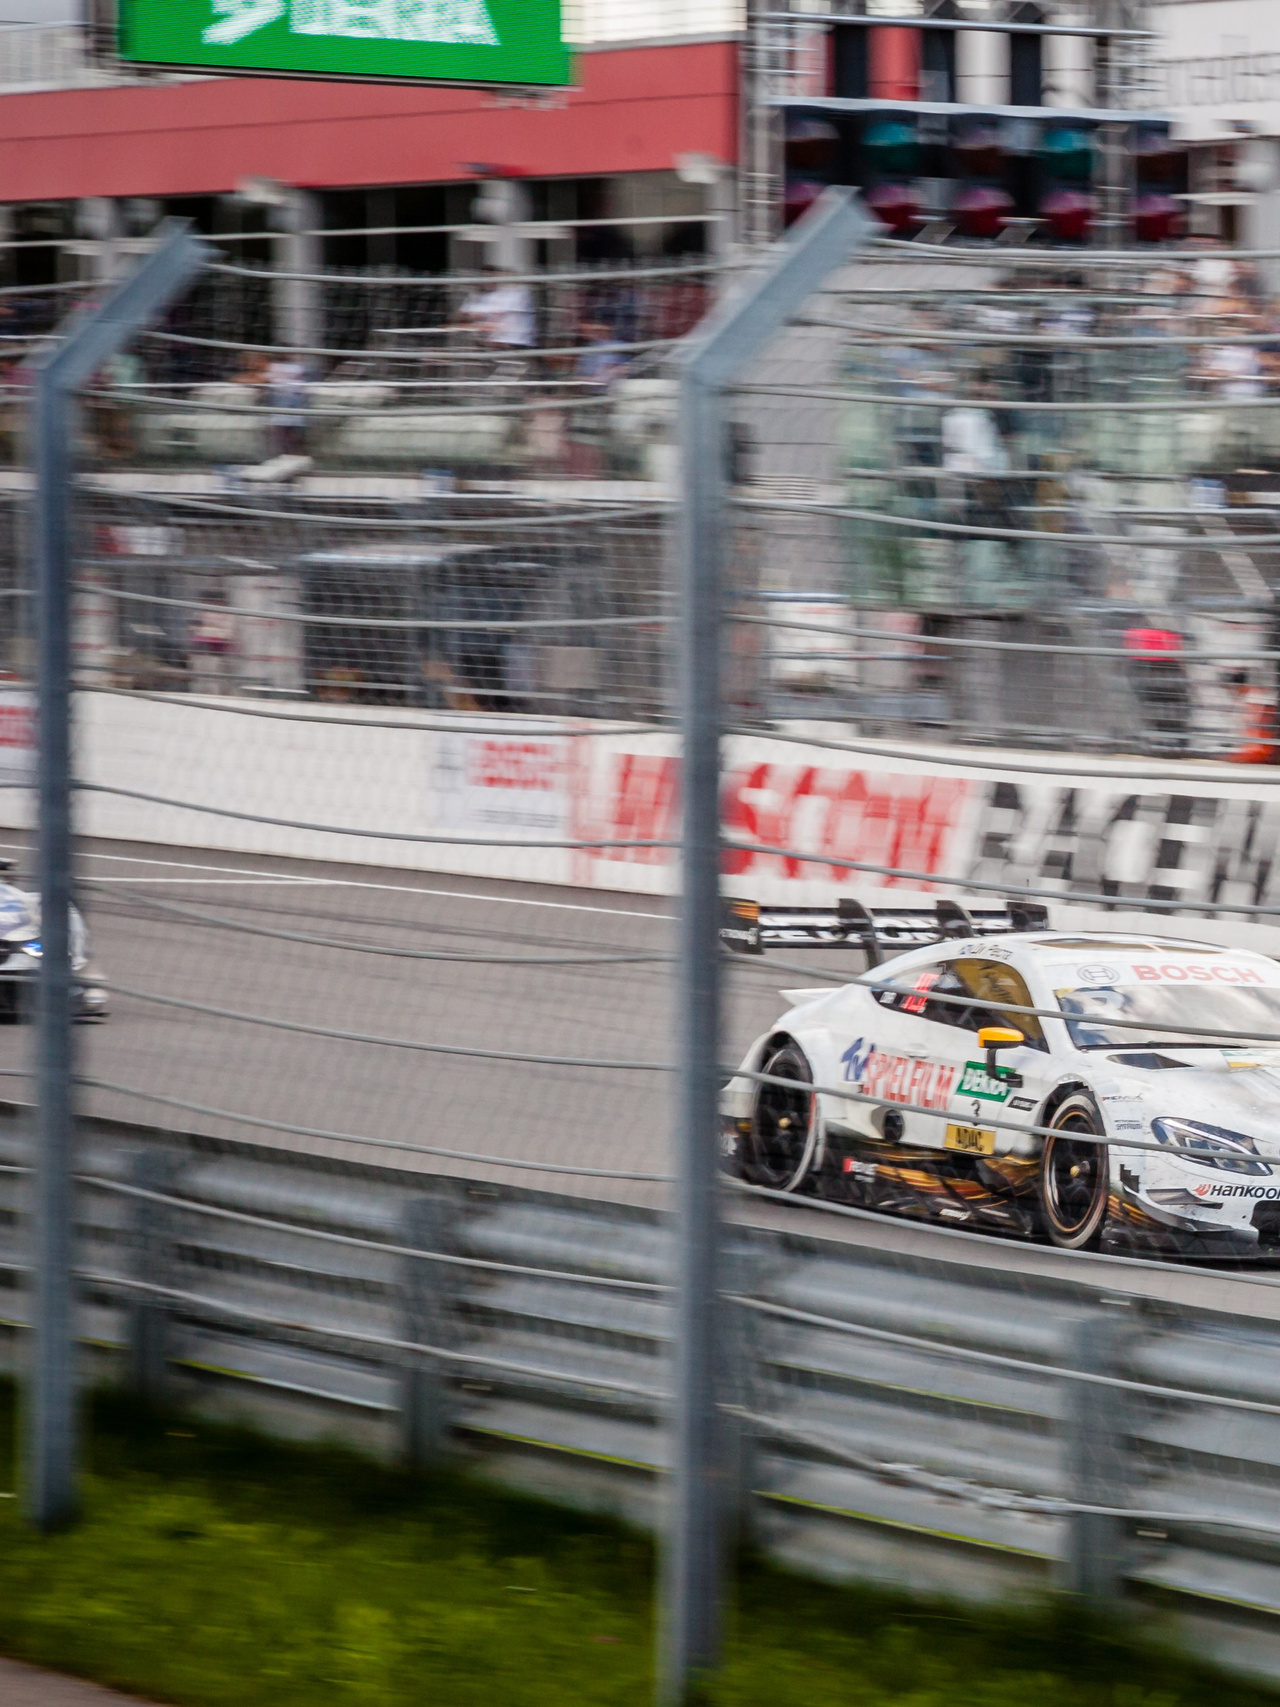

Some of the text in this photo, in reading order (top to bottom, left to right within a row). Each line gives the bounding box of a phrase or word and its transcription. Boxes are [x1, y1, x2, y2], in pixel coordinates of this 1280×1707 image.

[586, 752, 979, 892] MSCOW
[1131, 964, 1265, 984] BOSCH
[862, 1052, 955, 1111] SPIELFILM
